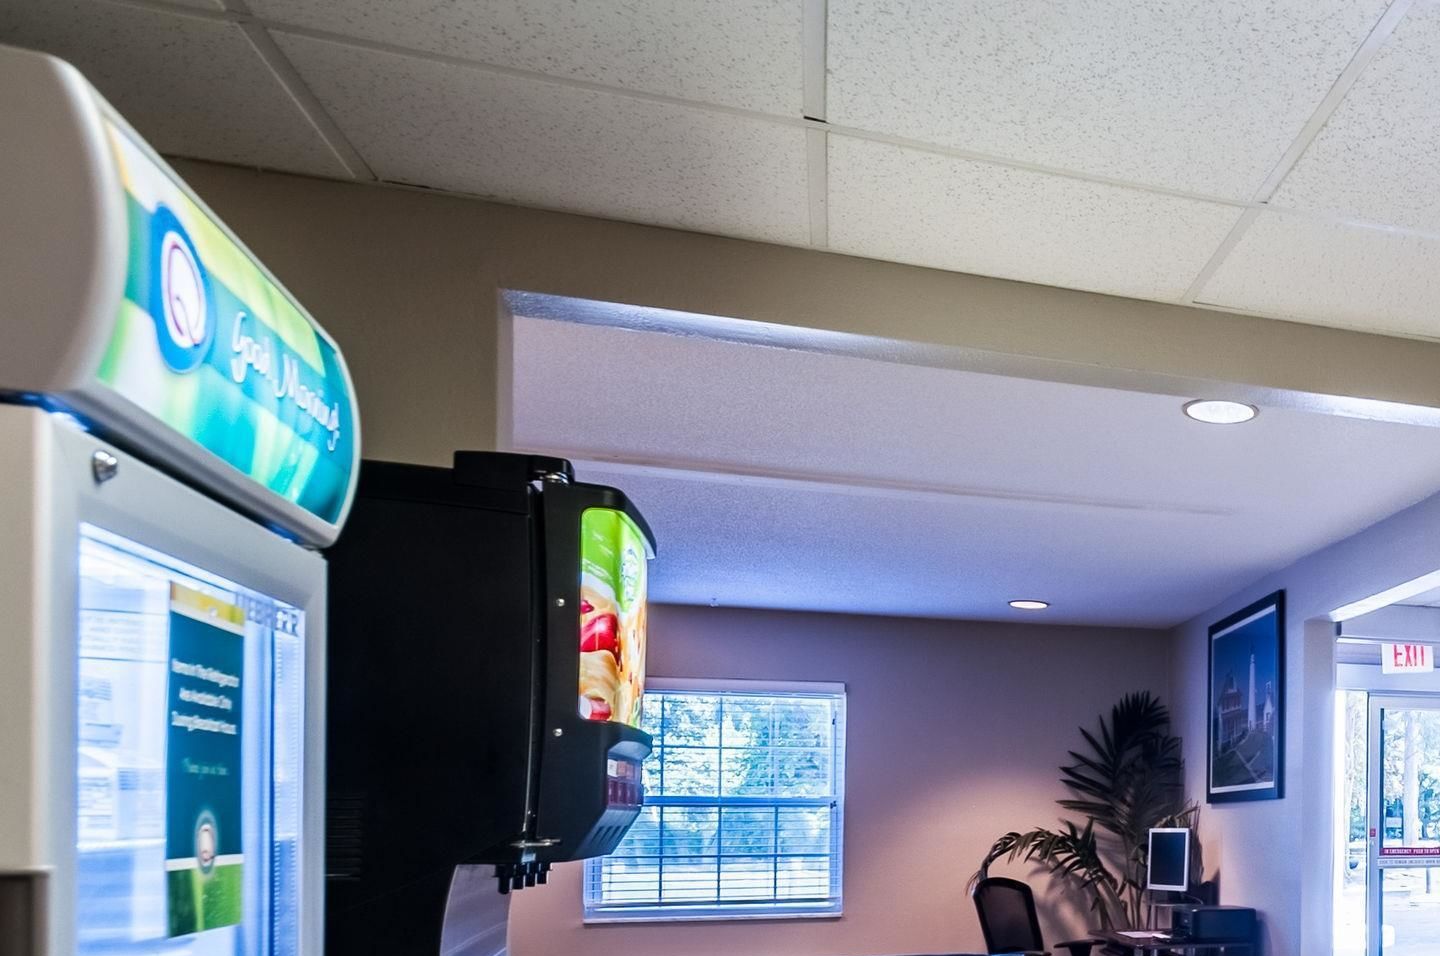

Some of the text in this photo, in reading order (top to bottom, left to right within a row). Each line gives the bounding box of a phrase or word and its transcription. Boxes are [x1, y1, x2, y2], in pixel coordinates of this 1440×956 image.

[231, 311, 341, 452] Good Morning
[1393, 644, 1425, 668] EXIT
